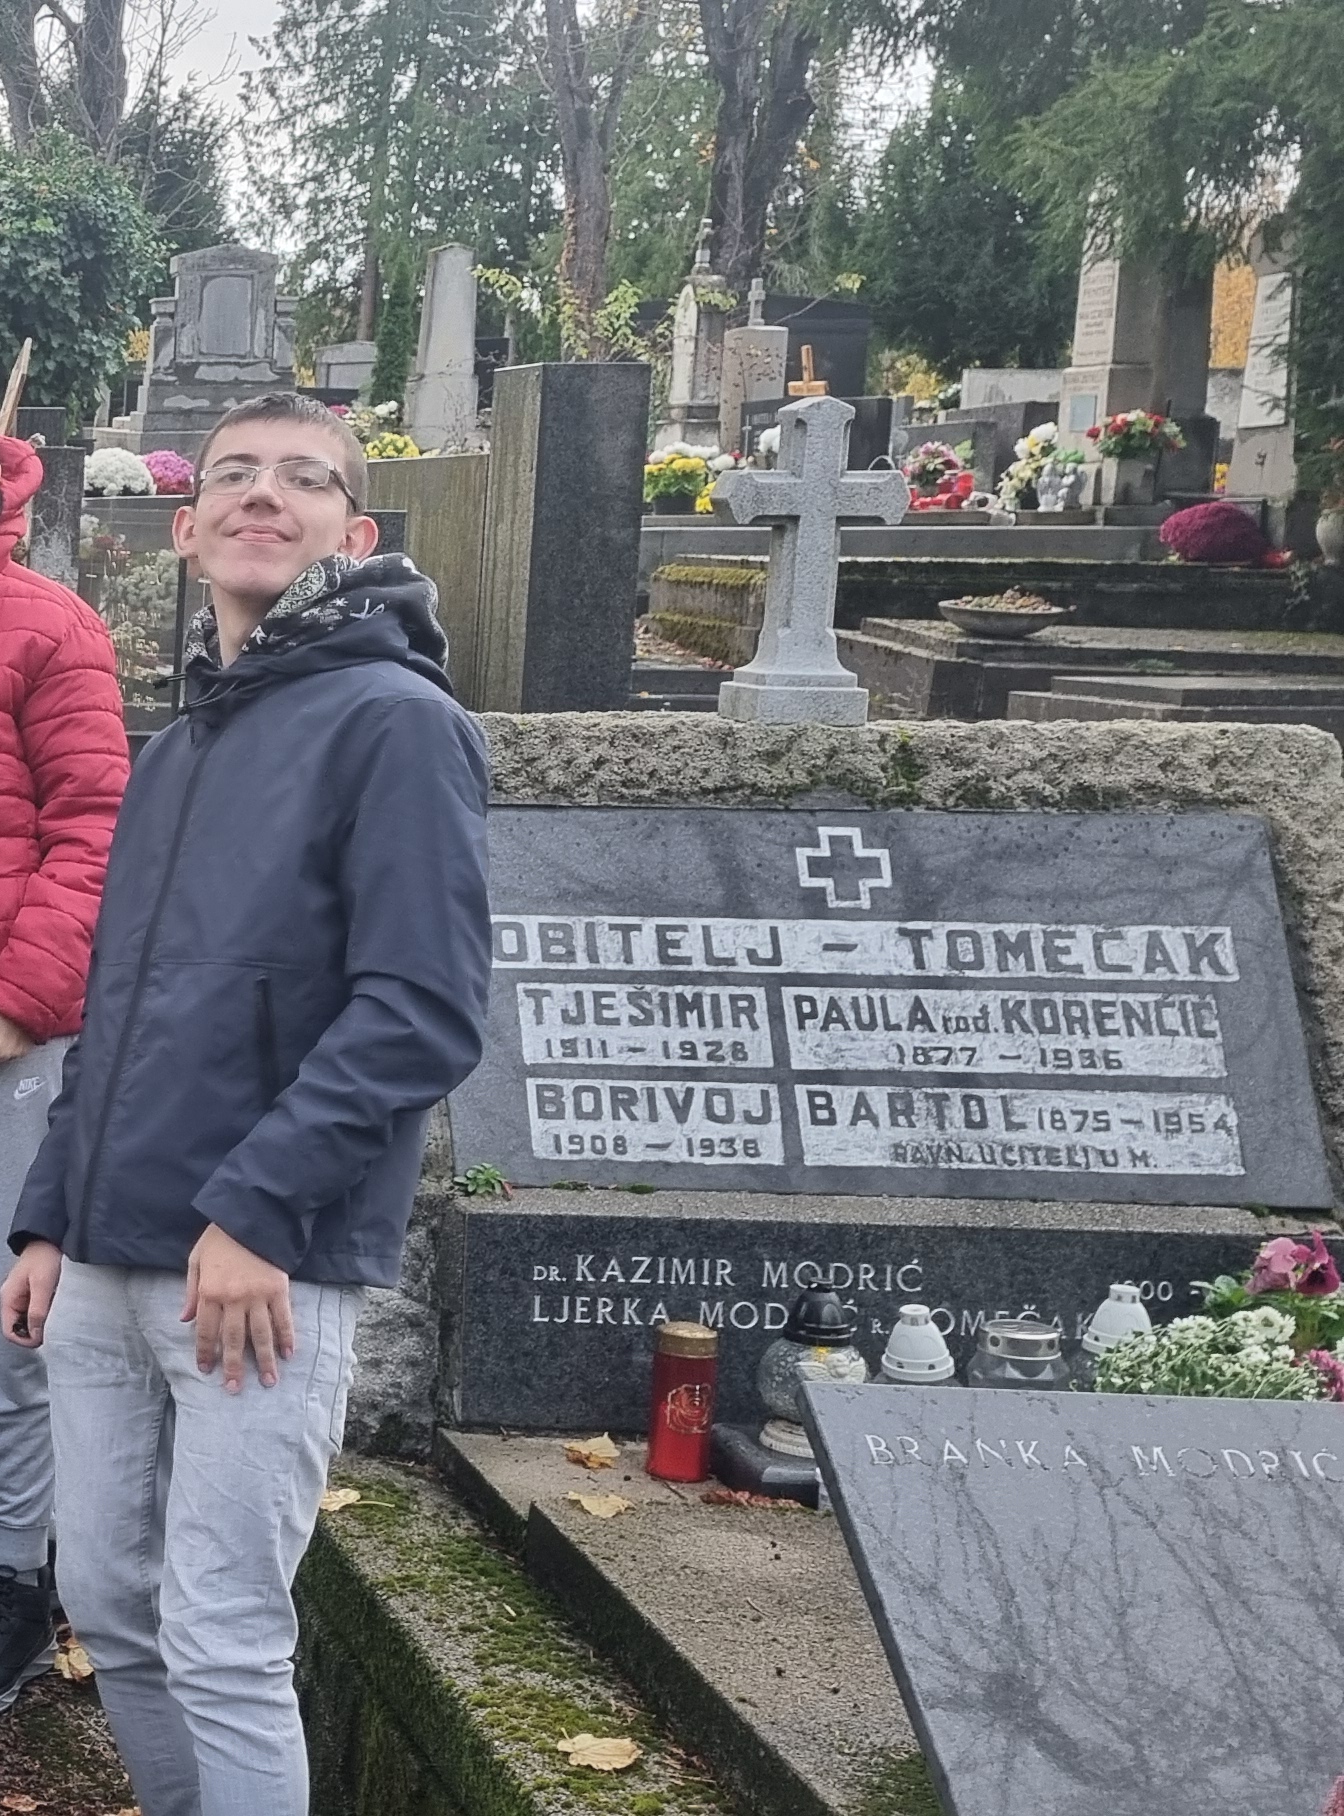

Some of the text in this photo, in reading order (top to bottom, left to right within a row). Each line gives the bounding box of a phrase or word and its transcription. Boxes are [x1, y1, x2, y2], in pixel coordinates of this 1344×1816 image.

[492, 920, 783, 967] OBITELJ
[523, 985, 760, 1031] TJEŠIMIR
[792, 993, 937, 1035] PAULA
[545, 1037, 610, 1058] 1911
[662, 1038, 749, 1062] 1928
[896, 1043, 978, 1067] 1877
[18, 1076, 41, 1091] NIKE
[535, 1083, 772, 1125] BORIVOJ
[806, 1089, 1027, 1132] BARTOL
[1037, 1106, 1111, 1133] 1875
[553, 1133, 629, 1156] 1908
[1100, 1148, 1119, 1168] U
[532, 1253, 923, 1293] DR. KAZIMIR MODRIĆ
[532, 1294, 671, 1326] LJERKA
[698, 1298, 859, 1333] MODĆ
[864, 1433, 1344, 1483] BRANKA MODRIĆ
